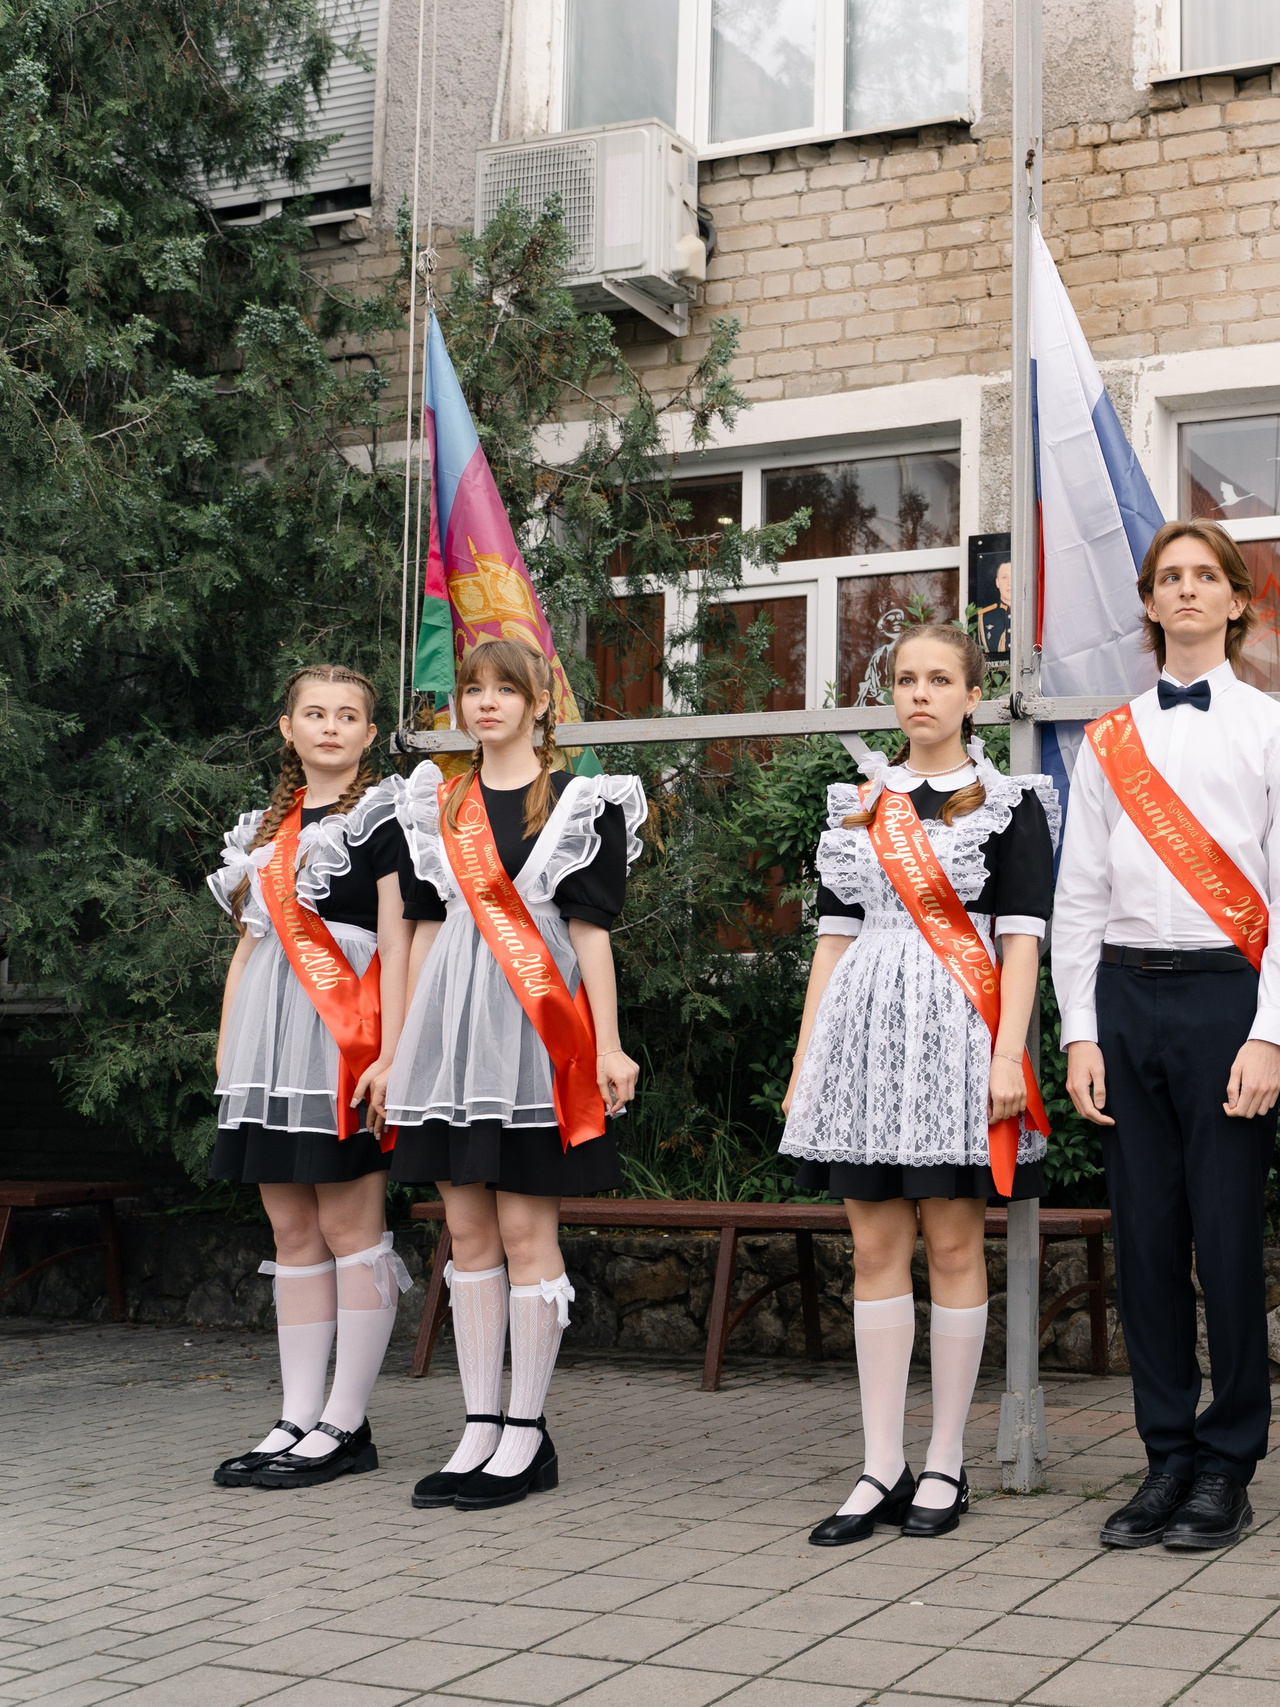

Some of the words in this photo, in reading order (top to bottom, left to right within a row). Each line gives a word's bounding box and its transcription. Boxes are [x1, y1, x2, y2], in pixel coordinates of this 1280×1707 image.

[260, 812, 312, 949] Выпускница
[298, 947, 350, 990] 2026
[452, 799, 524, 954] Выпускница
[510, 954, 559, 997] 2026
[483, 844, 511, 896] Винокурова
[505, 897, 530, 928] Арина
[881, 796, 952, 931] Выпускница
[949, 932, 998, 994] 2026
[1114, 744, 1231, 900] Выпускник
[1222, 895, 1267, 944] 2026
[1166, 797, 1199, 838] Кочерга
[1195, 835, 1222, 865] Иван
